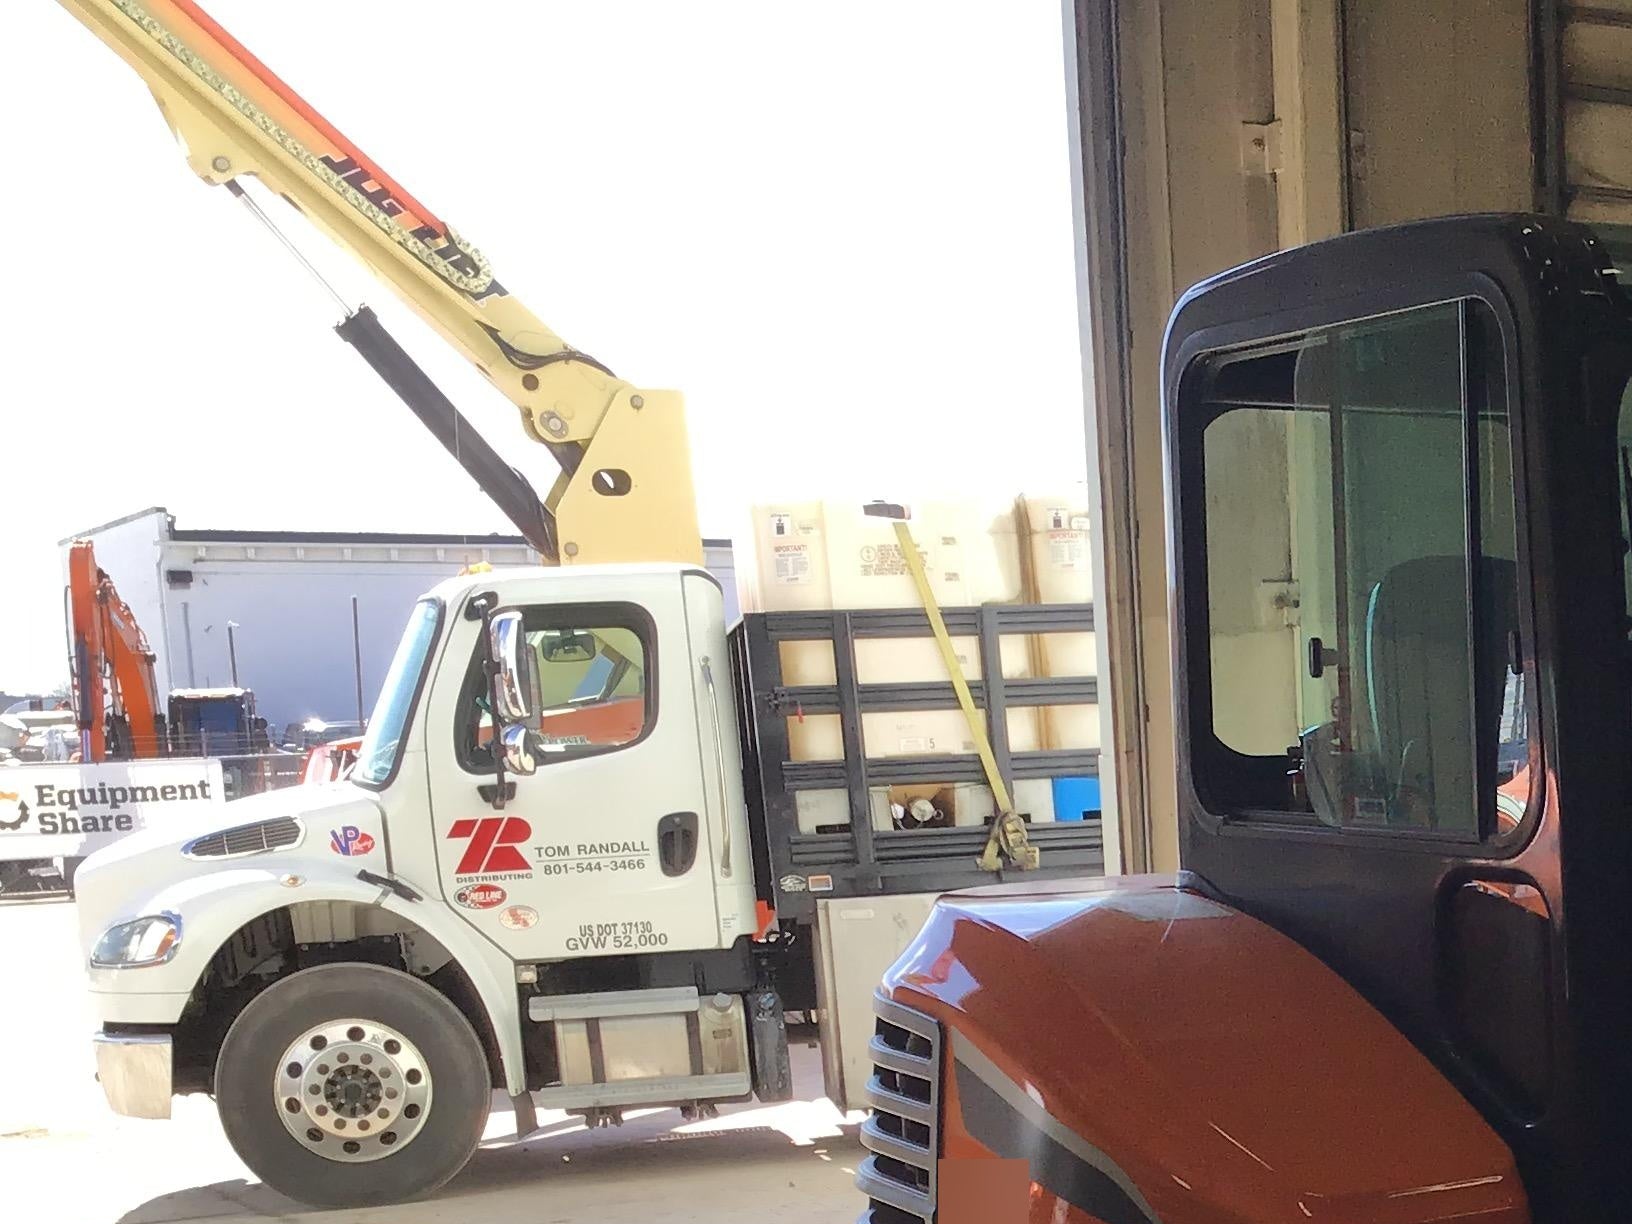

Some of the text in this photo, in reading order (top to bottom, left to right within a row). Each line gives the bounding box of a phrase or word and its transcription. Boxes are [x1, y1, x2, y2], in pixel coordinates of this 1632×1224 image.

[34, 779, 211, 811] Equipment
[37, 812, 133, 835] Share
[330, 825, 359, 856] VP
[534, 840, 650, 858] TOM RANDALL
[543, 858, 646, 876] 801-544-3466
[456, 872, 533, 884] DISTRIBUTING
[579, 921, 653, 937] US DOT 37130
[565, 932, 669, 951] GVW 52,000
